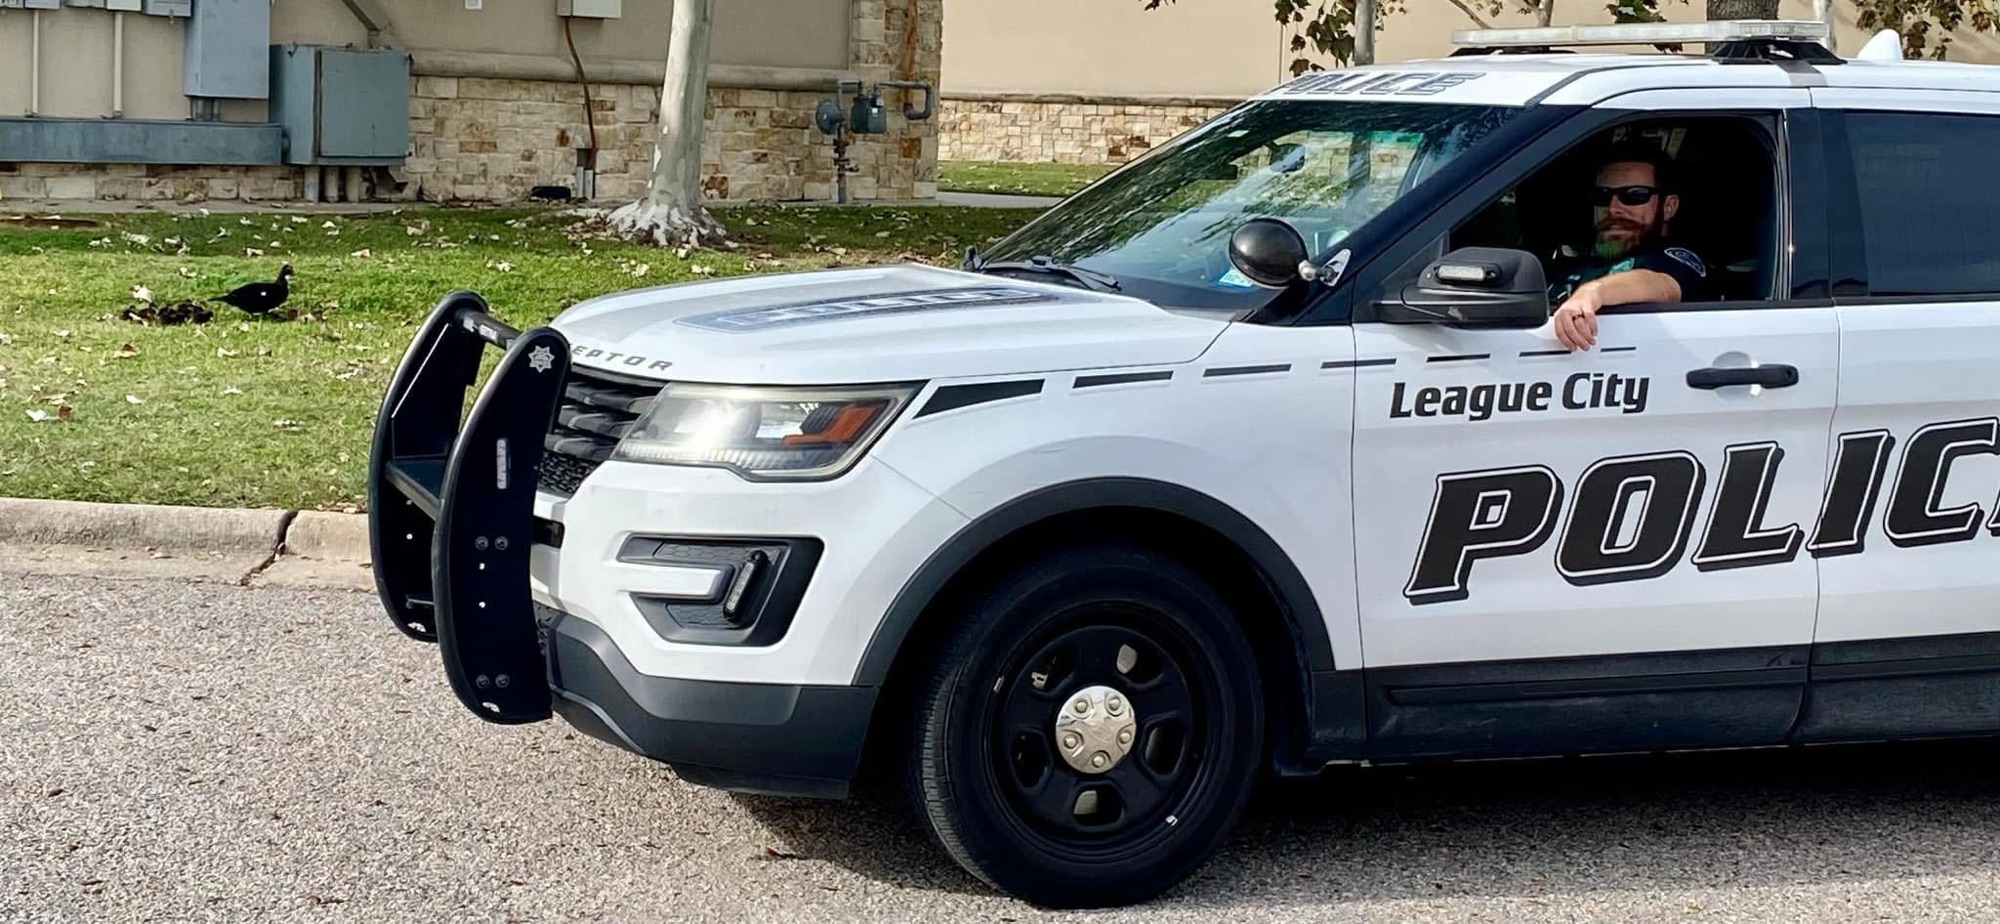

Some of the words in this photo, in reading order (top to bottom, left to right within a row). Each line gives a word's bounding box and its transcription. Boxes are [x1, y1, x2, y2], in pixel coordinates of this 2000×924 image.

[1389, 381, 1552, 421] League
[1562, 372, 1647, 414] City
[1403, 416, 2000, 605] POLIC
